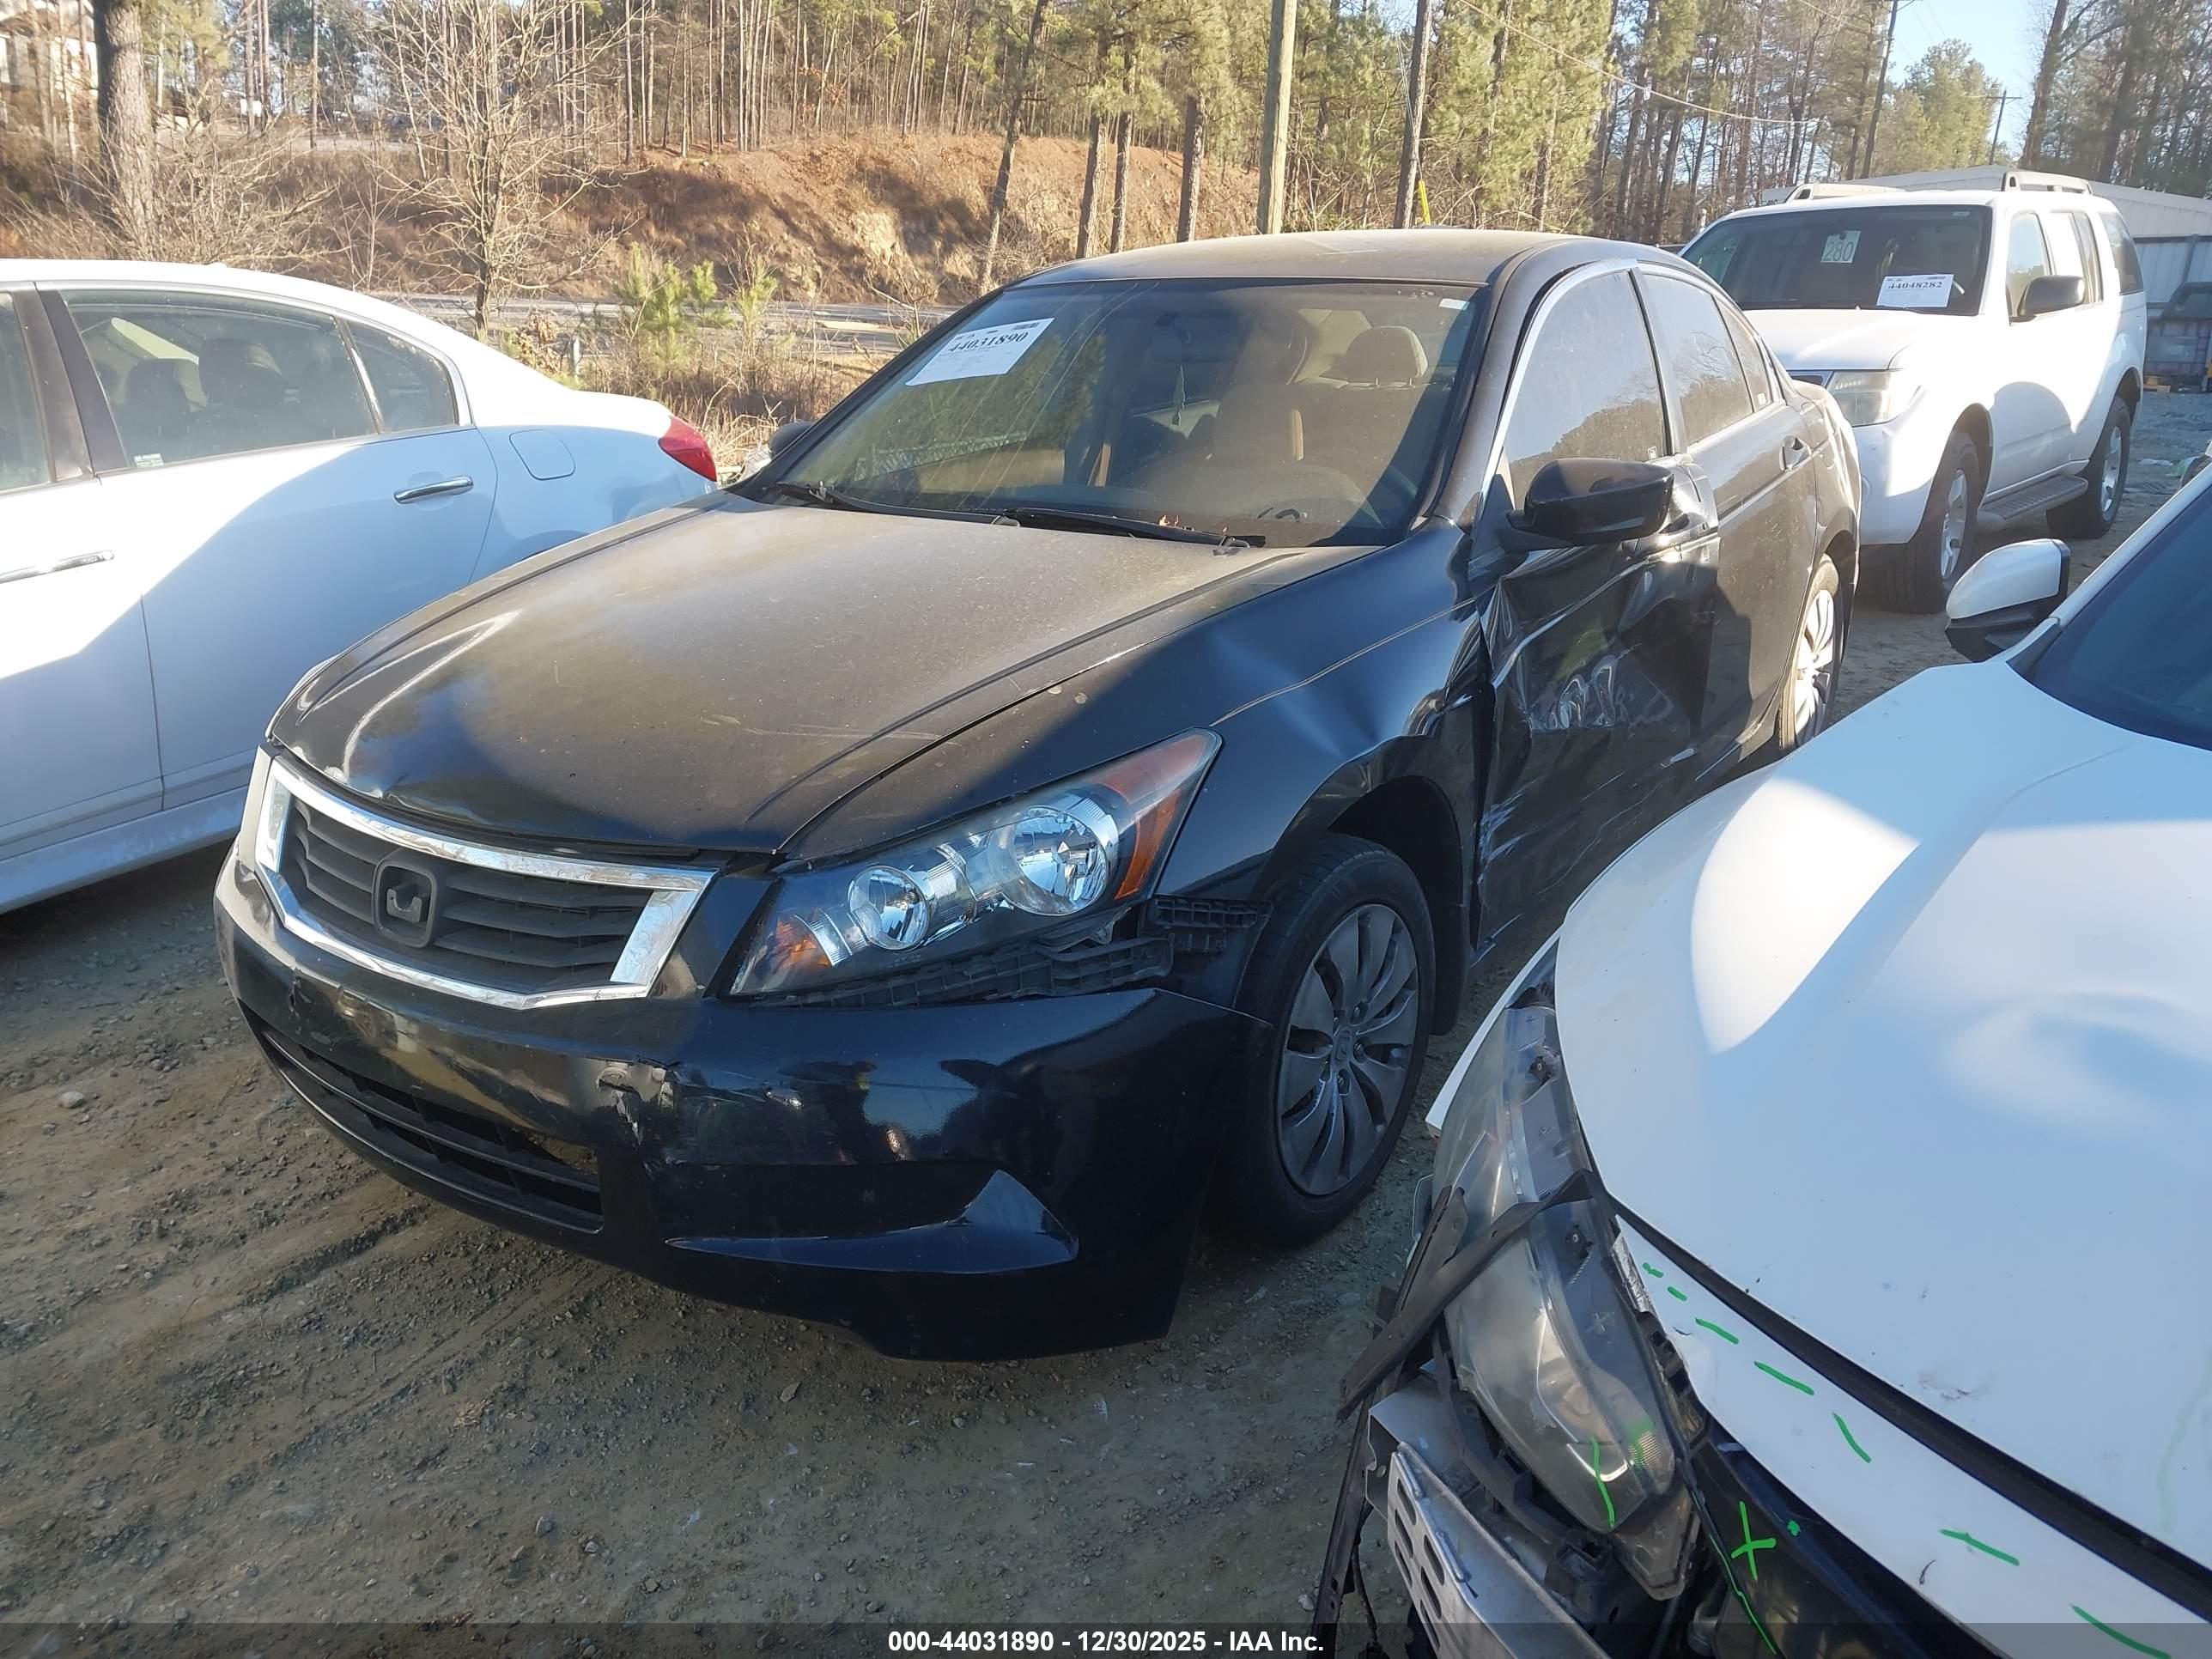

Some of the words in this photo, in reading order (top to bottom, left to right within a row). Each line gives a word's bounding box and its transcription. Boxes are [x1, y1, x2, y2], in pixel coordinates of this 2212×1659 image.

[1824, 241, 1855, 262] 280
[1888, 281, 1942, 289] 44048282
[948, 331, 1029, 352] 44031890
